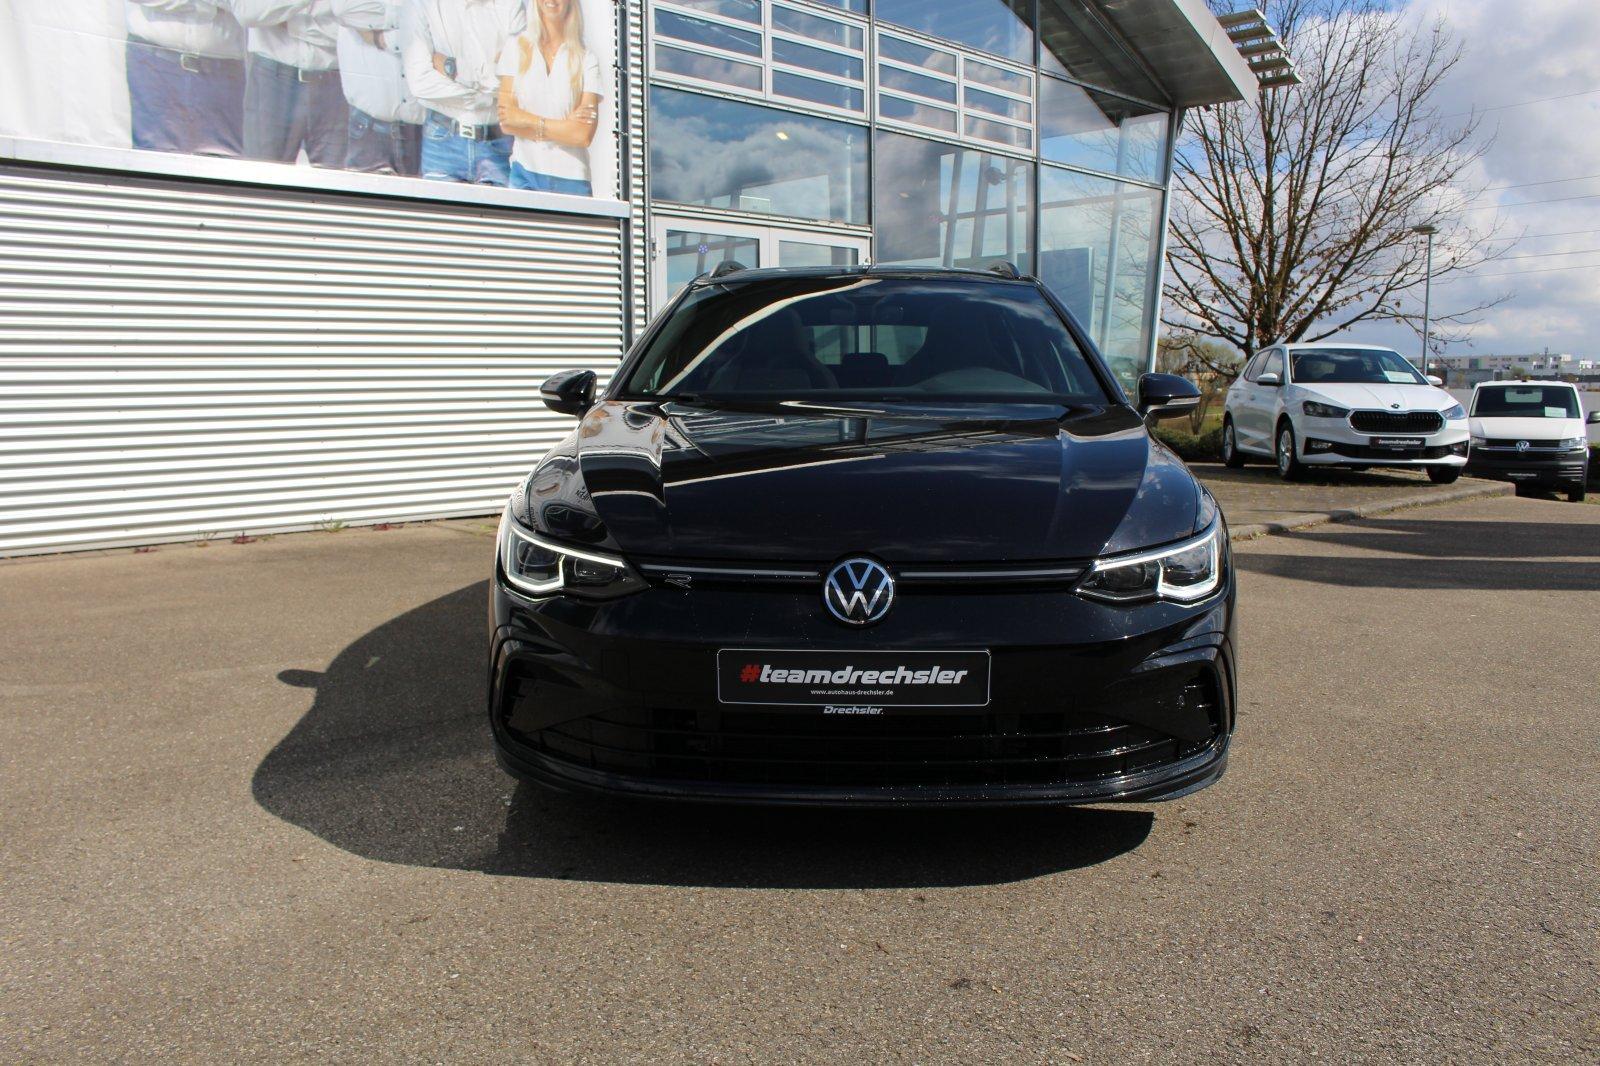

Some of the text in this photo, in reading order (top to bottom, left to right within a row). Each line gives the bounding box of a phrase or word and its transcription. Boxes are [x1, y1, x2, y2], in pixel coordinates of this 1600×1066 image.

[824, 558, 894, 624] VW
[740, 664, 968, 684] #teamdrechsler
[810, 689, 894, 697] www.autohaus-drechsler.de
